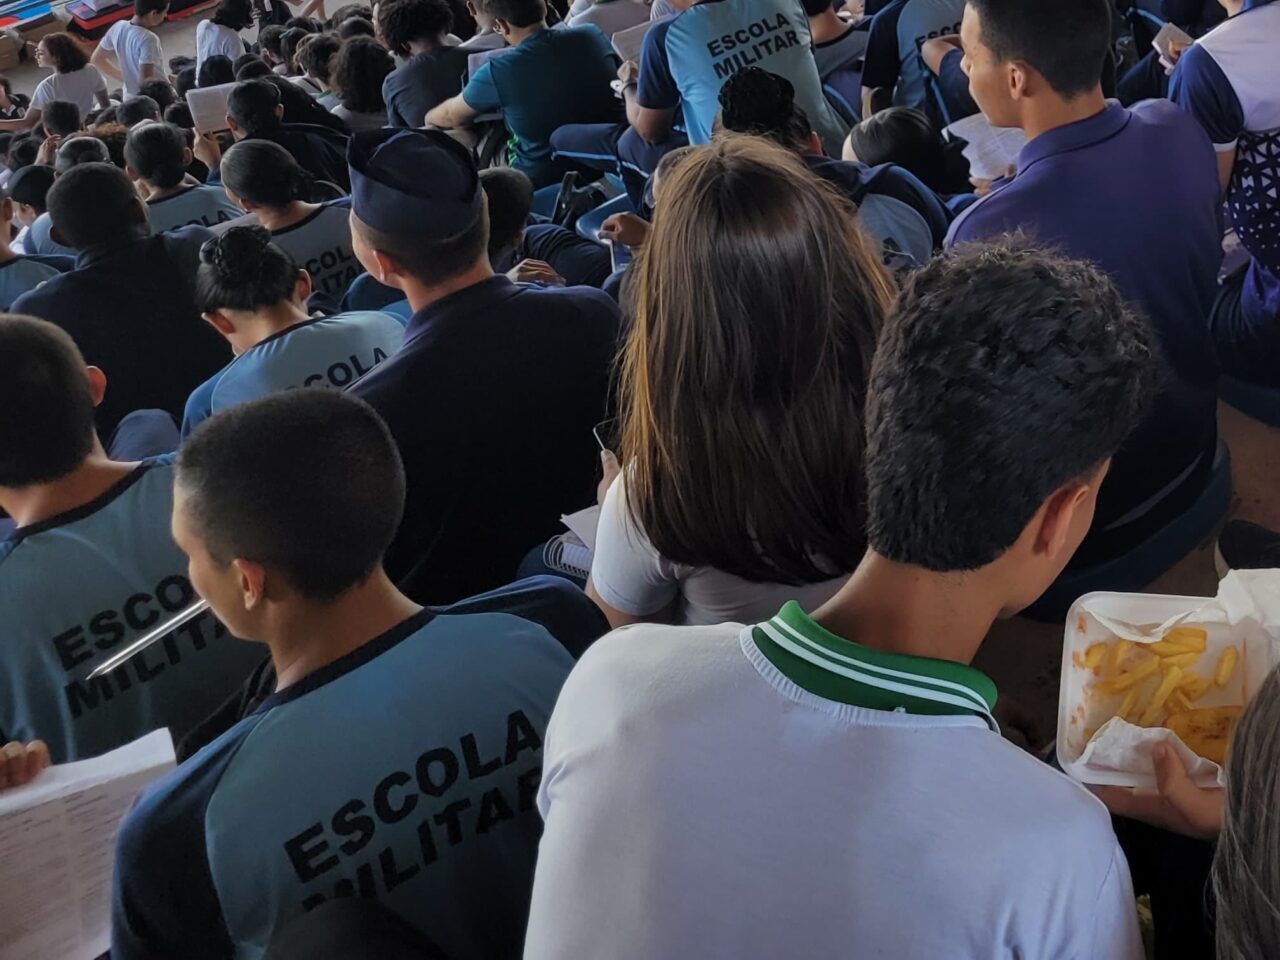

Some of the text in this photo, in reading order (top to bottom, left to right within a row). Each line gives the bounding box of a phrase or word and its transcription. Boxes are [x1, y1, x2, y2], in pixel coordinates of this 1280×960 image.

[706, 13, 790, 58] ESCOLA
[713, 30, 800, 79] MILITAR
[53, 574, 194, 672] ESCO
[283, 709, 542, 884] ESCOLA
